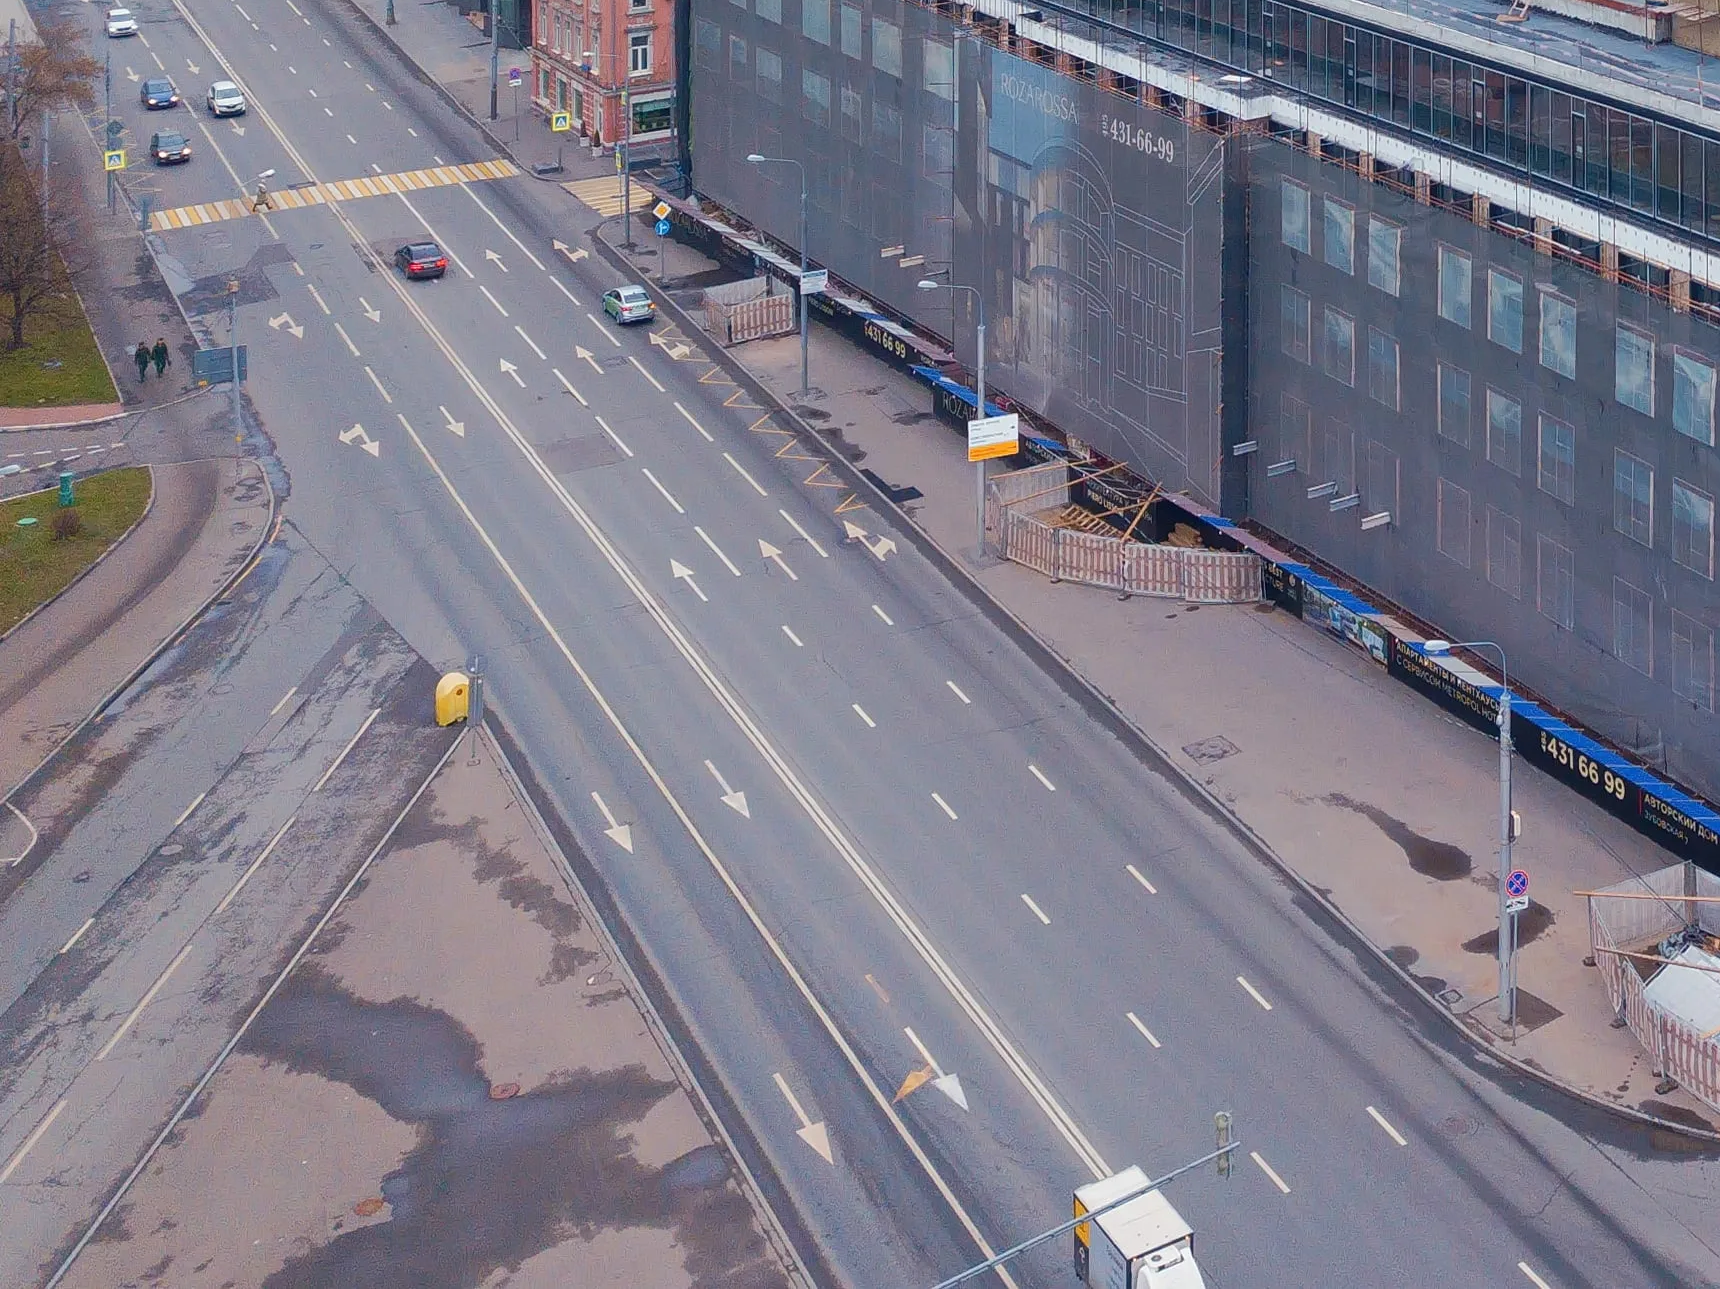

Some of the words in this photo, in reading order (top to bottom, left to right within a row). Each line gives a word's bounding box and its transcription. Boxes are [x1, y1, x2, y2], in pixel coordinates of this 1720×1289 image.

[1000, 73, 1078, 125] ROZAROSSA
[1110, 117, 1174, 163] 431-66-99
[868, 325, 881, 344] 431
[882, 332, 893, 351] 66
[894, 340, 906, 358] 99
[1547, 737, 1574, 770] 431
[1578, 755, 1599, 784] 66
[1604, 770, 1626, 800] 99
[1697, 825, 1718, 845] ДОМ
